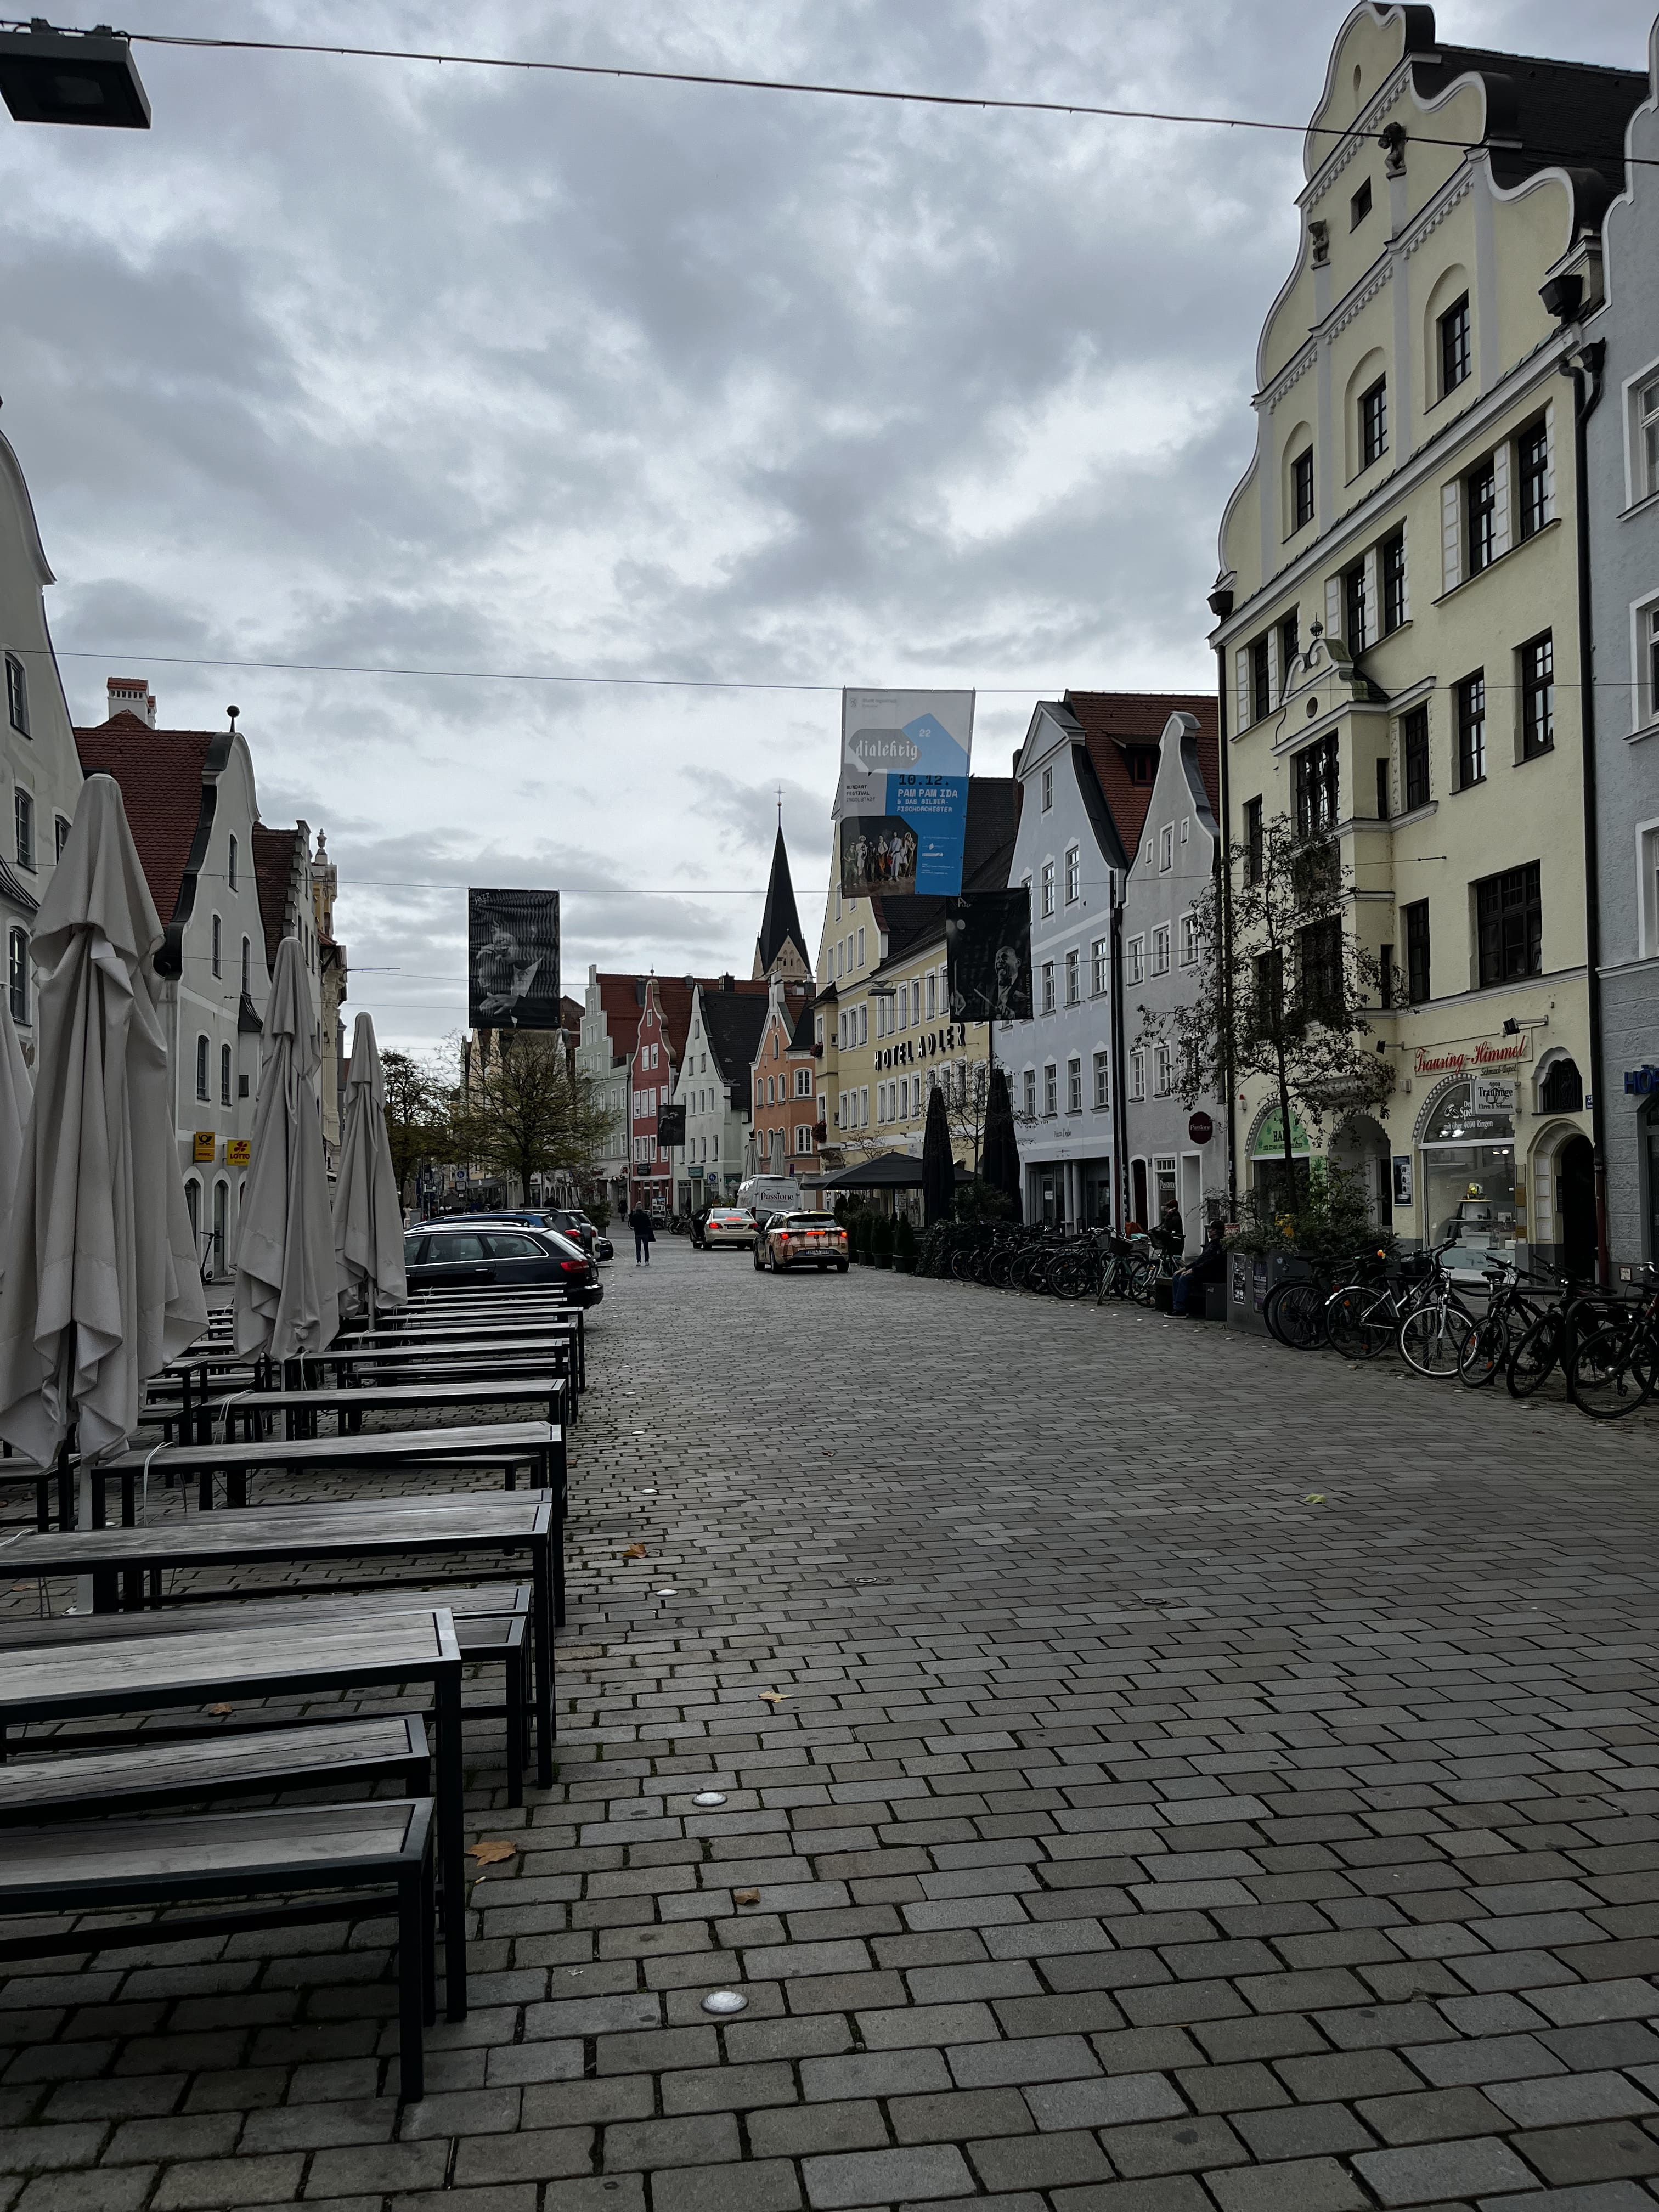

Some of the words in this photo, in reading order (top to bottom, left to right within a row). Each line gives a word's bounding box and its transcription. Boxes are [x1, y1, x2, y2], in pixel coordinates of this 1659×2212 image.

[919, 729, 931, 737] 22
[856, 740, 918, 761] dialektig
[899, 775, 949, 786] 10.12.
[898, 789, 916, 797] PAM
[940, 789, 958, 798] IDA
[874, 1040, 914, 1071] HOTEL
[917, 1023, 966, 1058] ADLER
[1414, 1035, 1526, 1075] Trauring-Himmel
[1478, 1087, 1513, 1098] Trauringe
[1460, 1107, 1472, 1121] Spe
[1452, 1121, 1463, 1130] über
[1464, 1121, 1476, 1129] 4000
[1476, 1119, 1493, 1130] Ringen
[1273, 1130, 1285, 1142] HA
[761, 1190, 794, 1200] Passione
